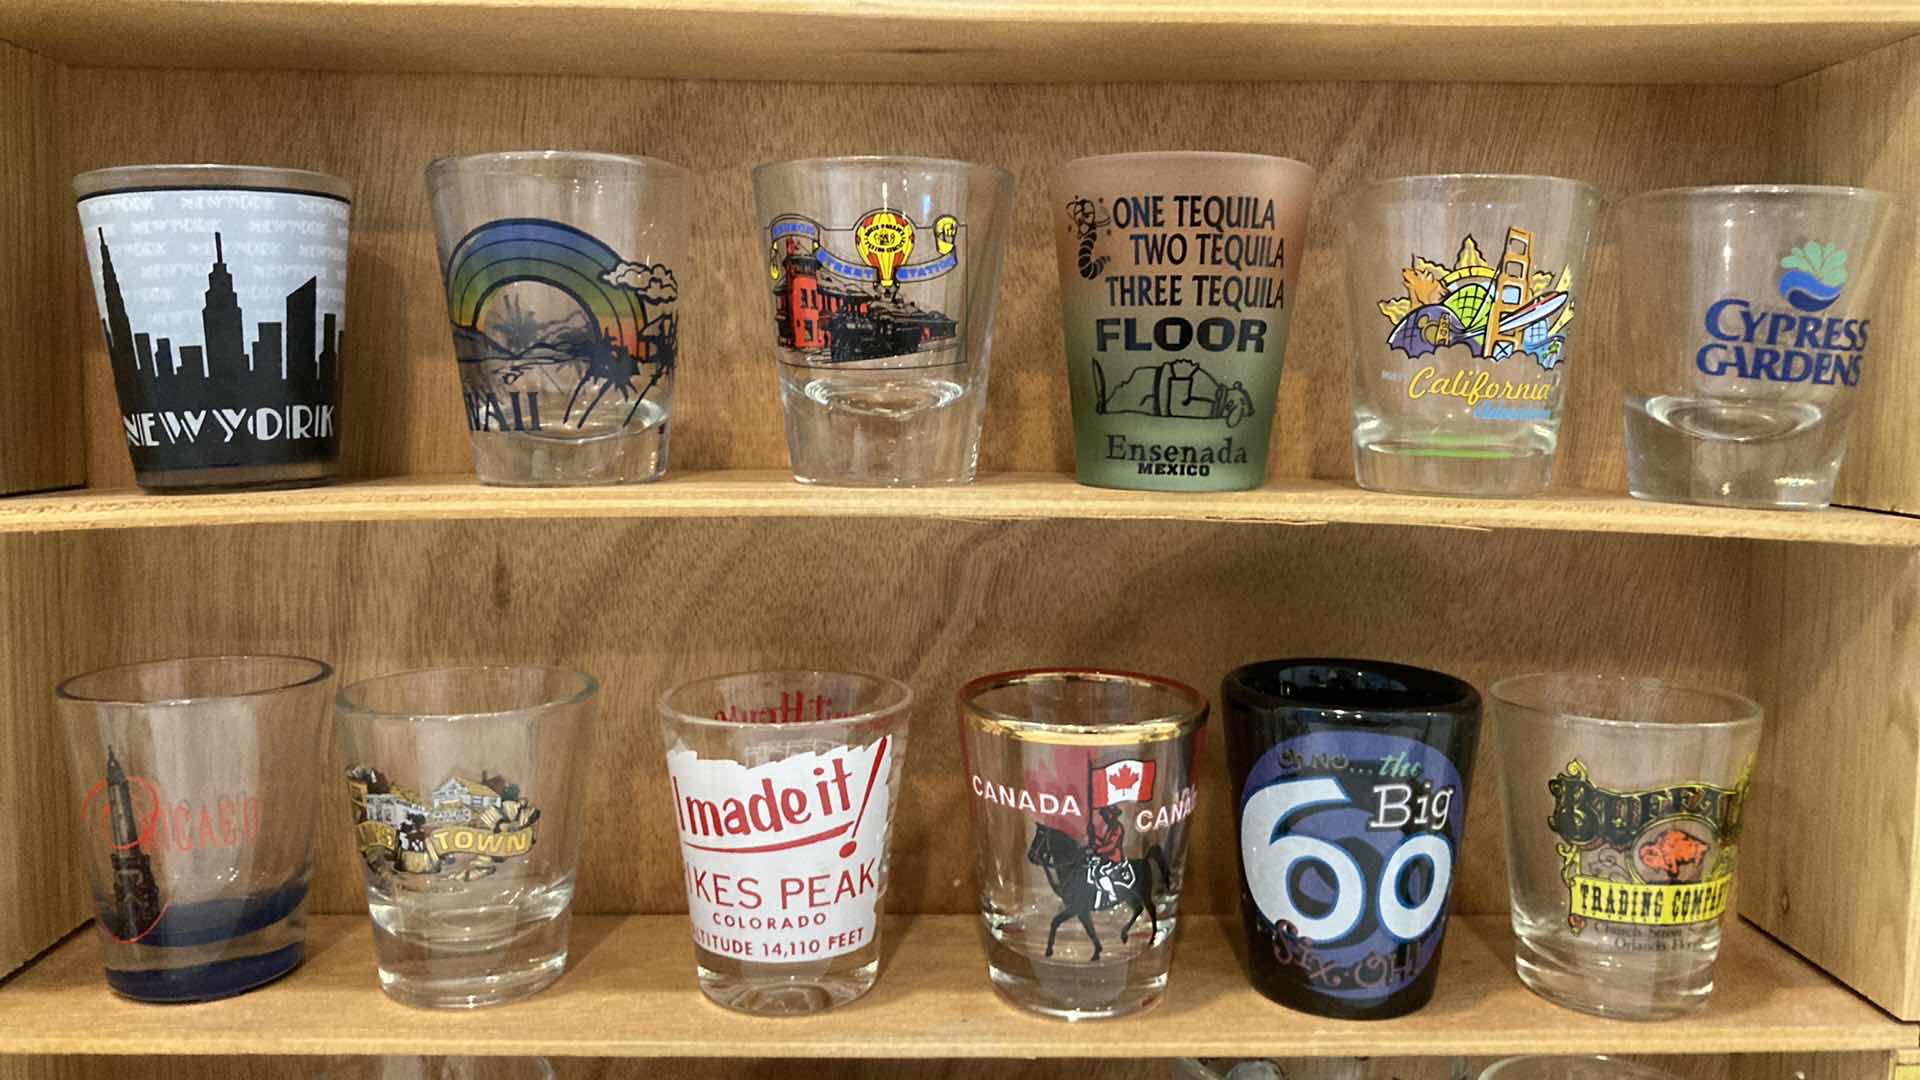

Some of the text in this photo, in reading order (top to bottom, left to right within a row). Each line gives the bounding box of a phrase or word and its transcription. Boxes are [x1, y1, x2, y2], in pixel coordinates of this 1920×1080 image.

[1113, 195, 1275, 232] ONE TEQUILA
[1130, 233, 1284, 270] TWO TEQUILA
[1106, 275, 1284, 312] THREE TEQUILA
[1097, 317, 1267, 352] FLOOR
[1705, 299, 1870, 352] CYPRESS
[1696, 344, 1863, 387] GARDENS
[1408, 367, 1550, 406] California
[212, 404, 334, 443] YORK
[1106, 434, 1248, 464] Ensenada
[1138, 463, 1210, 476] MEXICO
[1379, 752, 1422, 778] the
[673, 776, 685, 831] I
[685, 778, 811, 836] made
[972, 775, 1081, 816] CANADA
[1370, 781, 1454, 830] Big
[434, 831, 526, 852] TOWN
[1240, 775, 1454, 945] 60
[780, 858, 876, 910] PEAK
[1580, 882, 1665, 919] TRADING
[713, 911, 826, 931] COLORADO
[763, 940, 819, 958] 14,110
[828, 928, 863, 949] FEET
